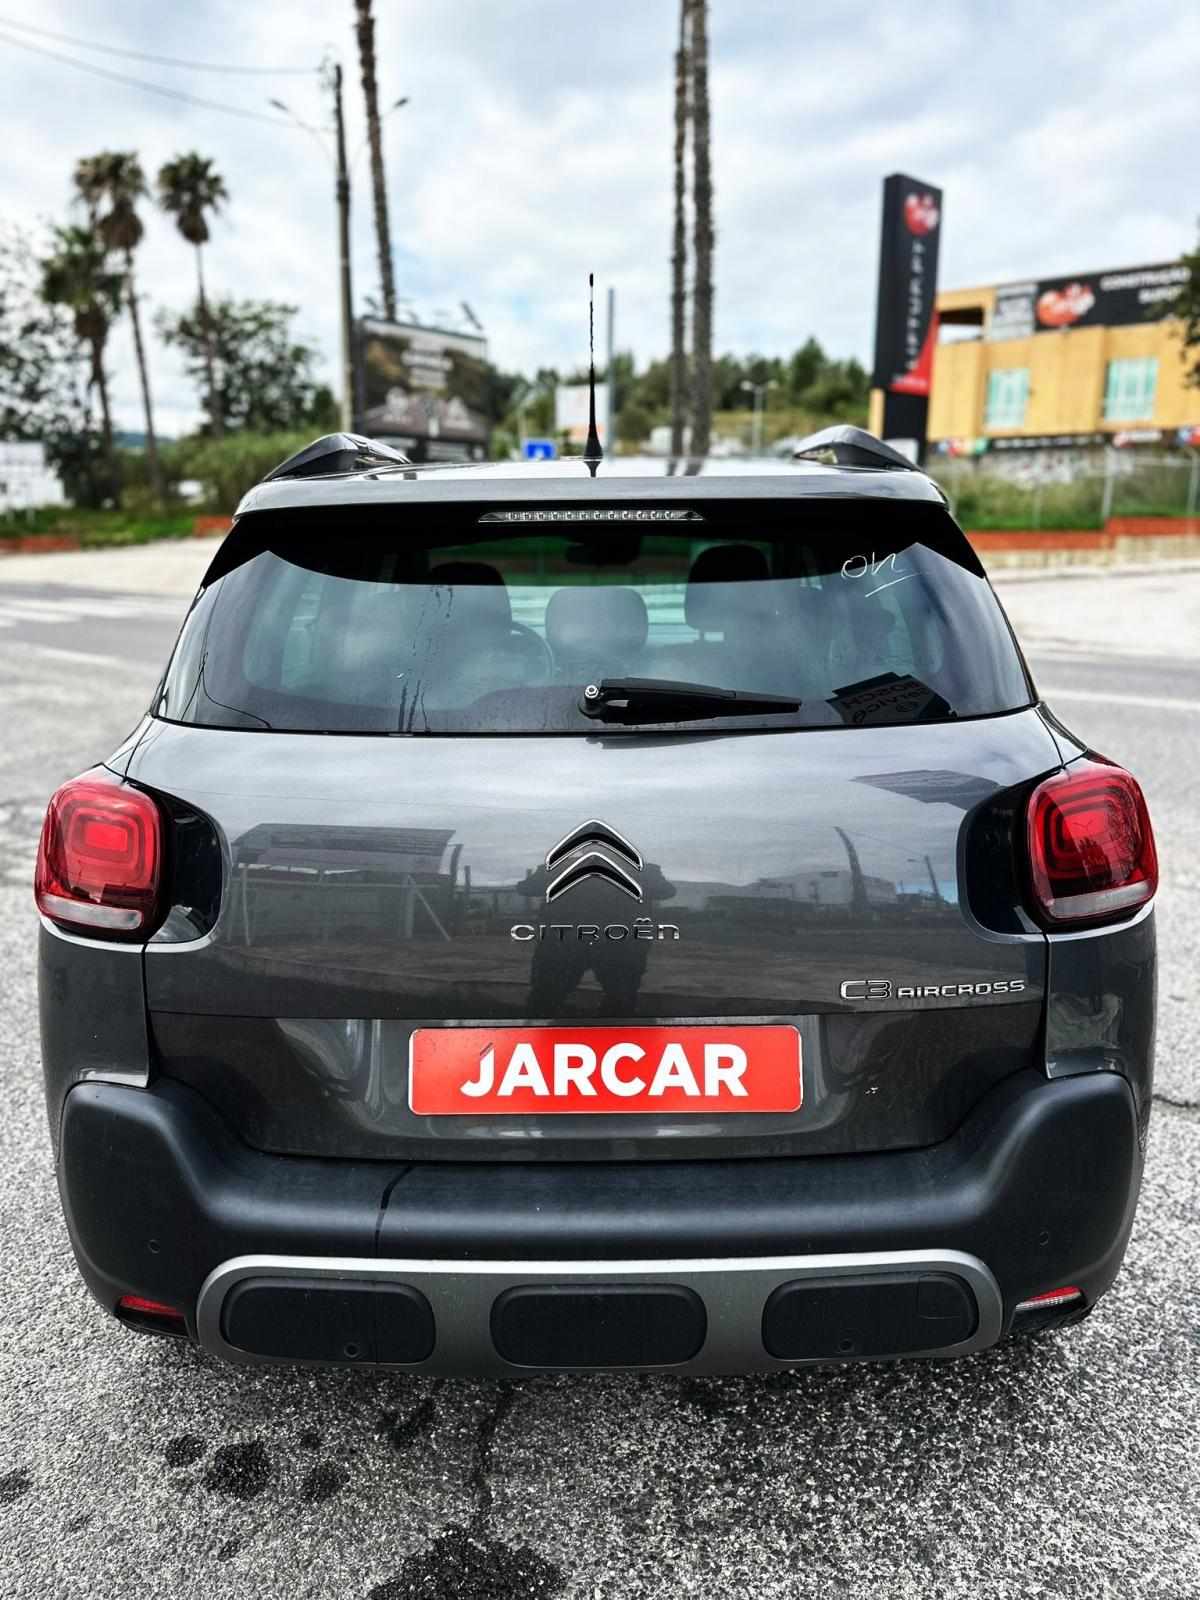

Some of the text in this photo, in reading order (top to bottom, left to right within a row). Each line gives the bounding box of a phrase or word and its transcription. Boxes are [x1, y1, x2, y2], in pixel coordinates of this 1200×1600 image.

[510, 917, 680, 941] CITROËN
[840, 979, 892, 1000] C3
[459, 1042, 749, 1097] JARCAR
